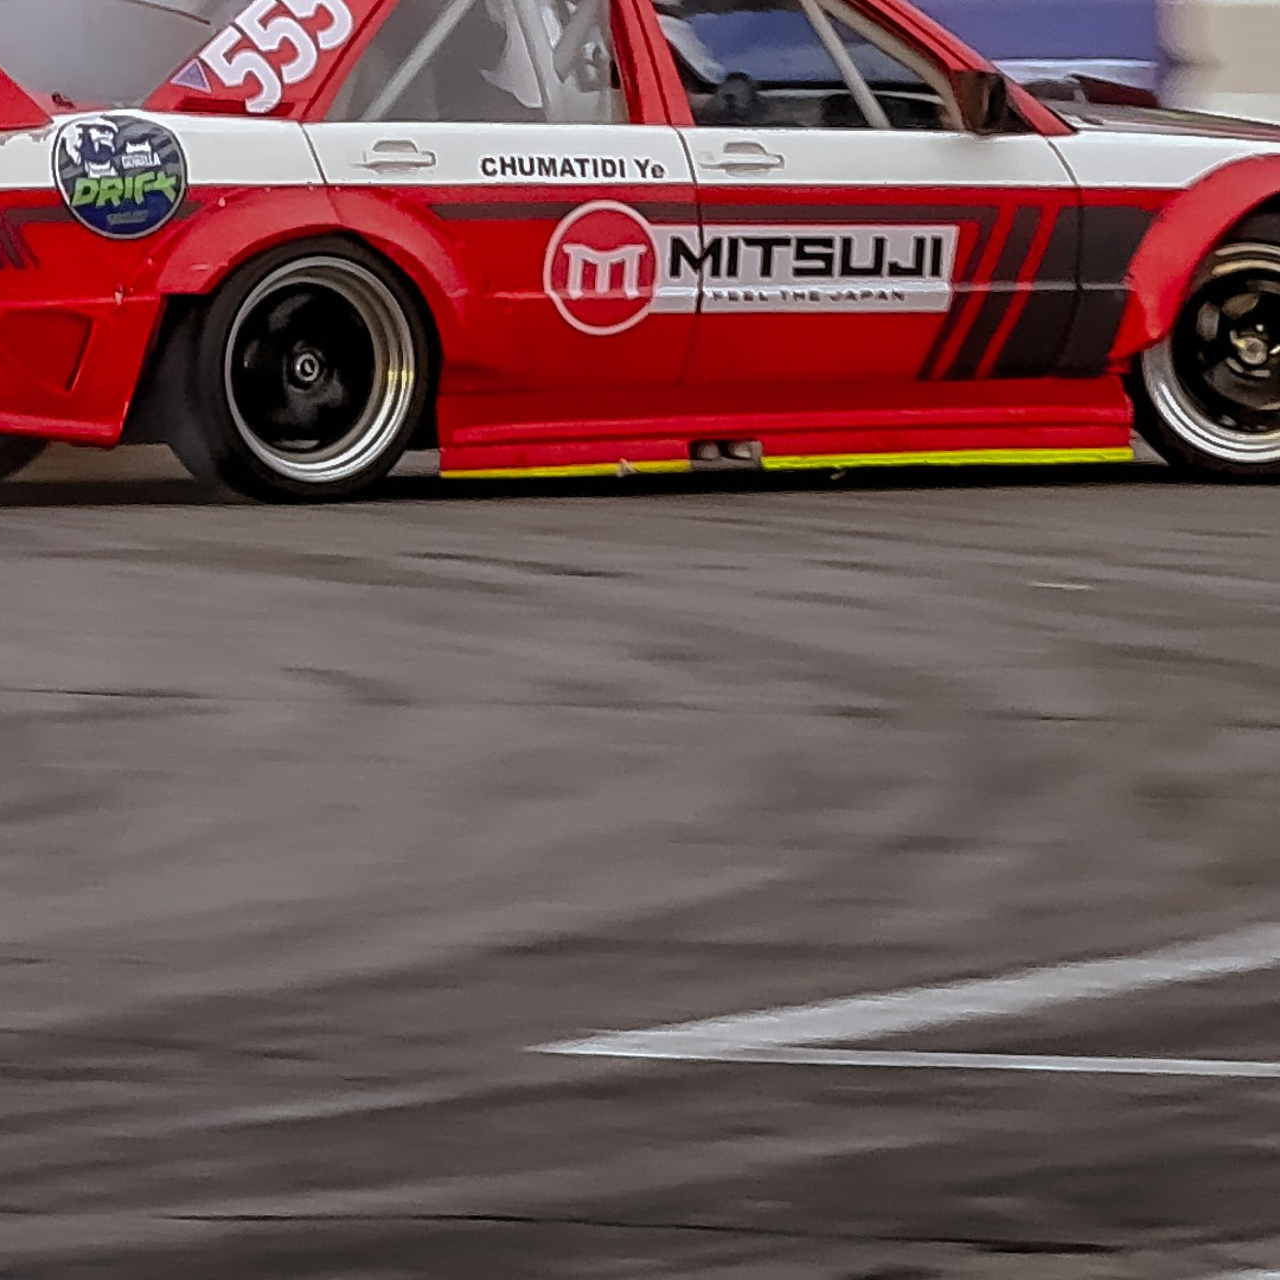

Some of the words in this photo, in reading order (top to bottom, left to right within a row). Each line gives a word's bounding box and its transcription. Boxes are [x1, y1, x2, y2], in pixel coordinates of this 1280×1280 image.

[480, 156, 626, 178] CHUMATIDI
[71, 170, 177, 207] DRIFT
[670, 236, 943, 278] MITSUJI
